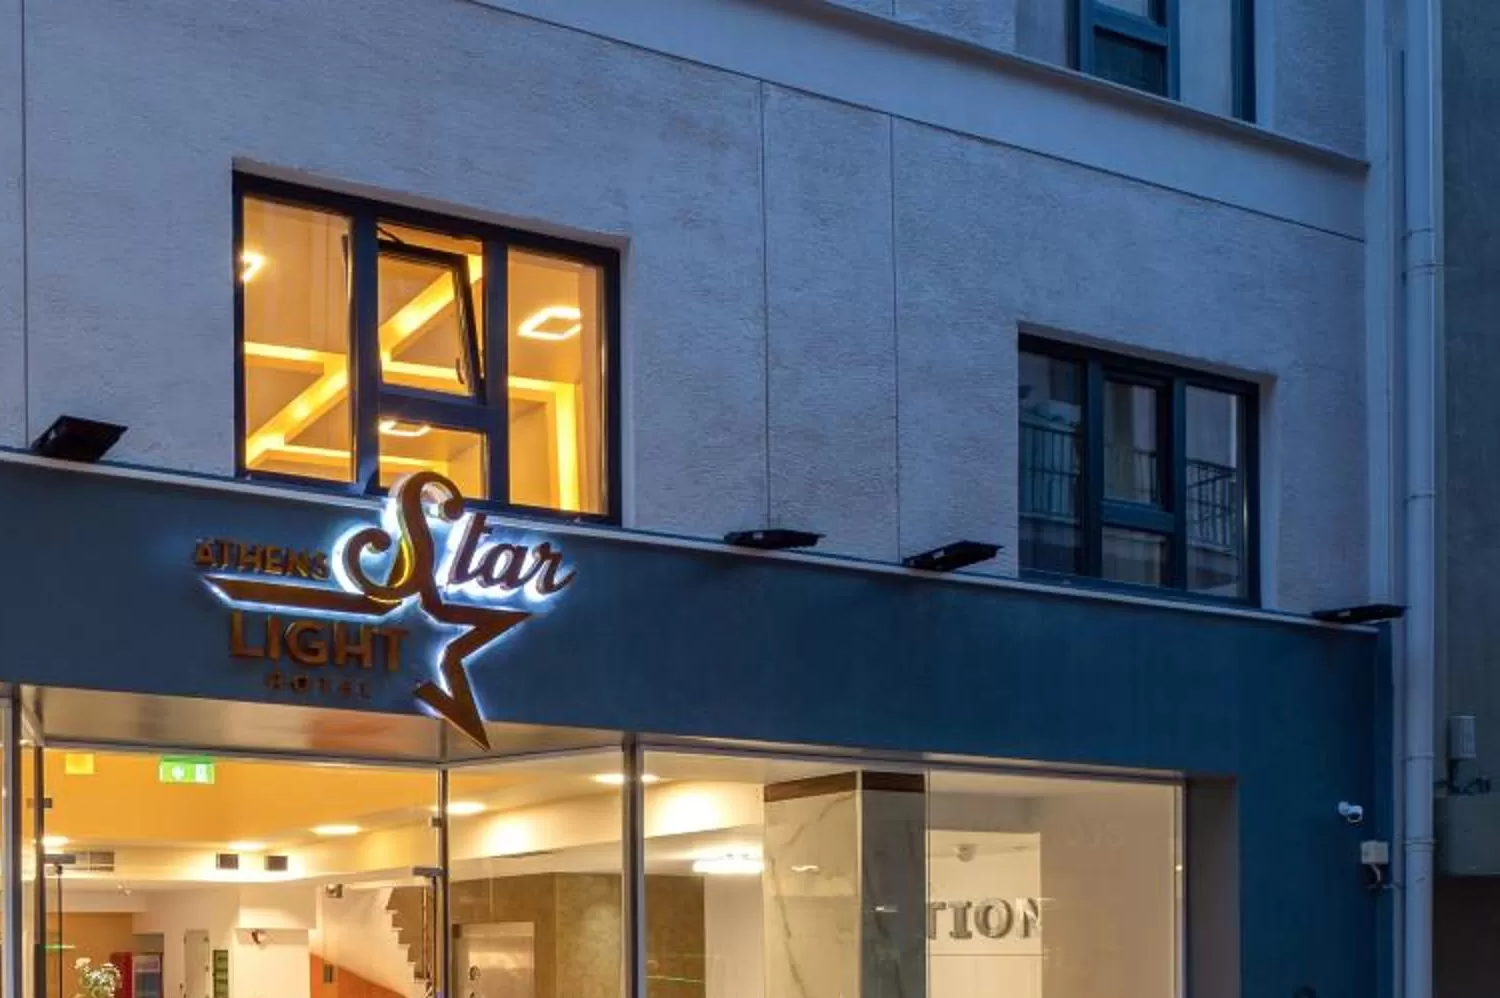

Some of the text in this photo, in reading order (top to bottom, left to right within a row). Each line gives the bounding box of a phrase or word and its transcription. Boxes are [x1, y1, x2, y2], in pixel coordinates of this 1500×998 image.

[196, 471, 577, 604] ATHENS Star
[230, 610, 409, 673] LIGHT
